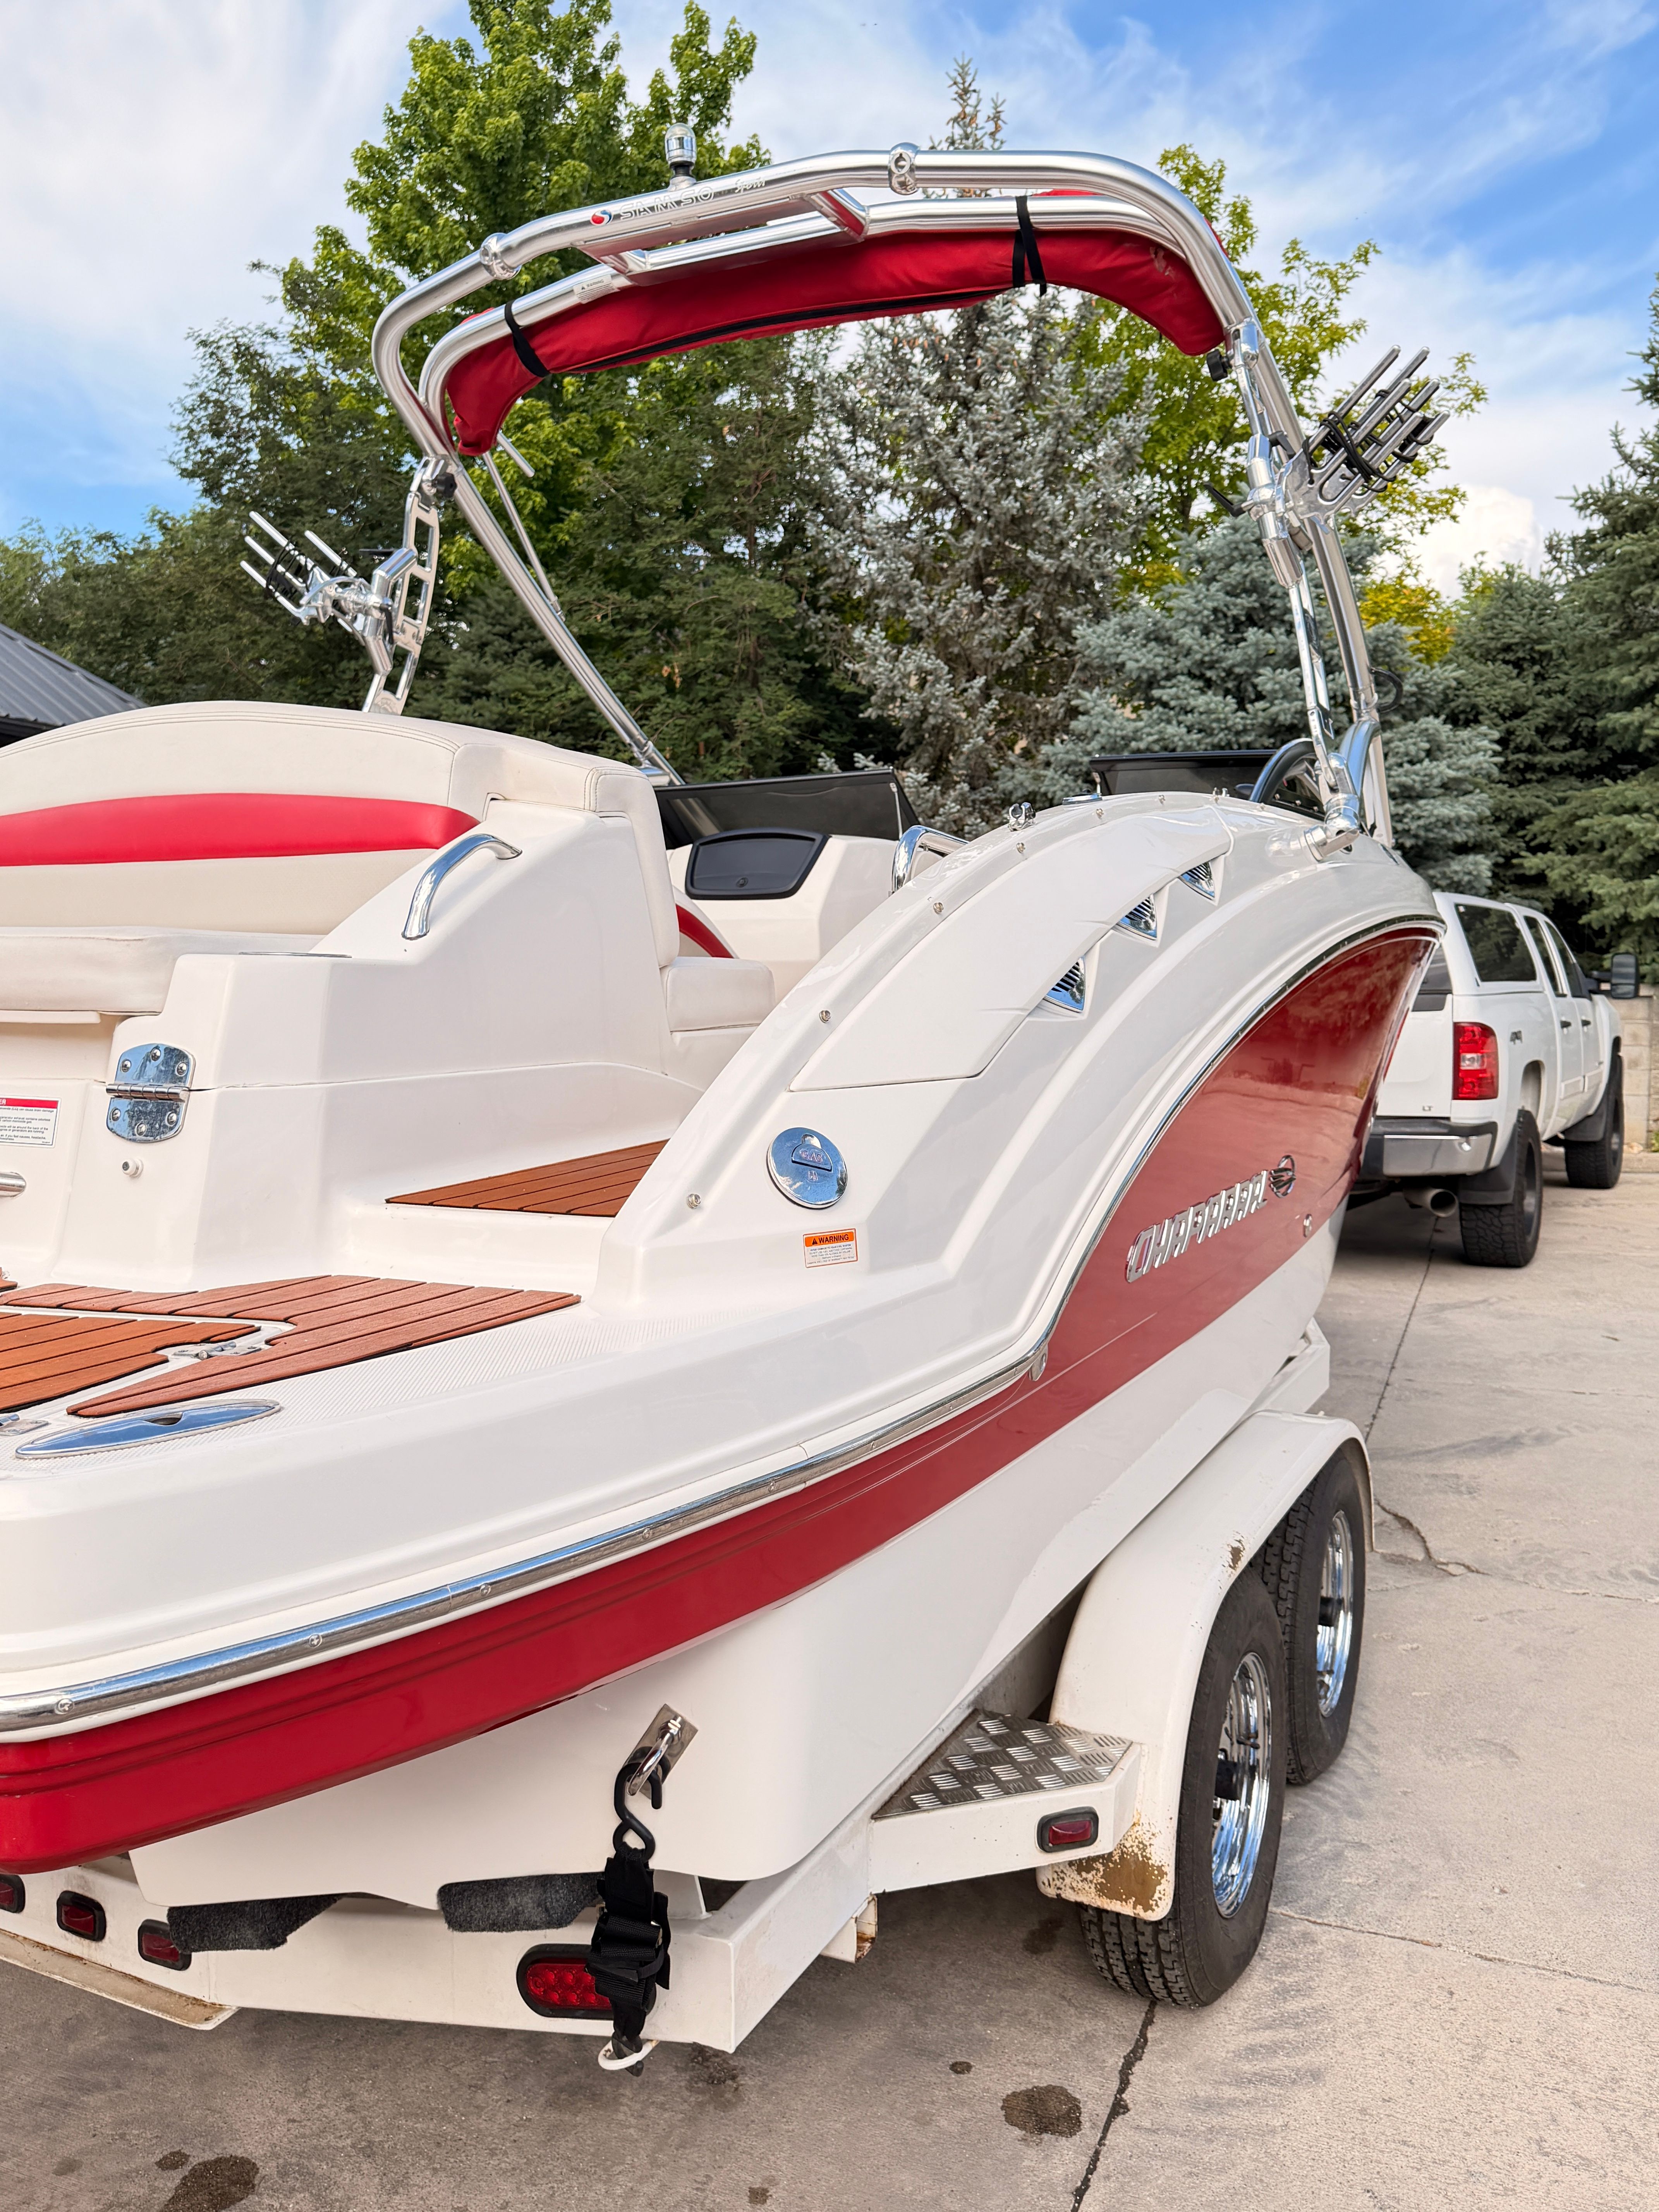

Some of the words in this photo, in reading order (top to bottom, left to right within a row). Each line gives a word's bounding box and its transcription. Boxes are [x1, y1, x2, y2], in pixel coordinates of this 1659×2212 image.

[799, 1149, 823, 1163] GAS
[1126, 1170, 1269, 1283] CHAPARRAL
[818, 1234, 849, 1244] WARNING
